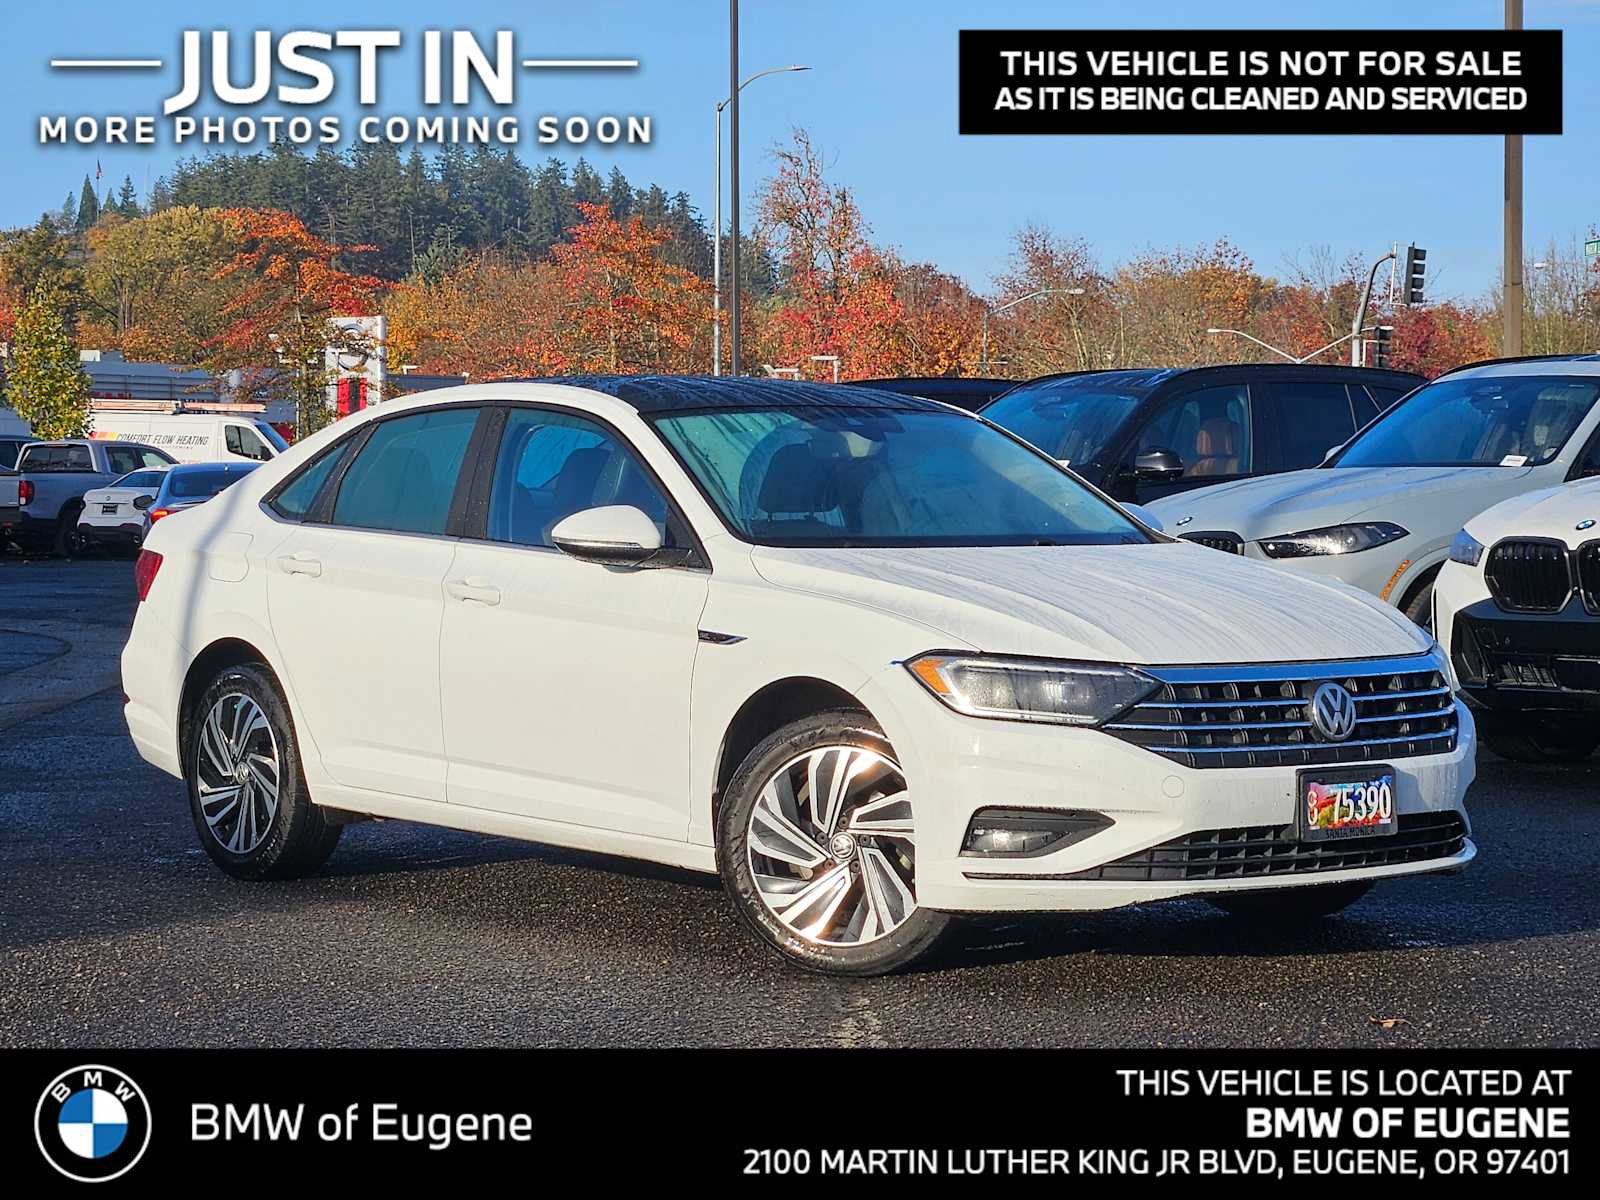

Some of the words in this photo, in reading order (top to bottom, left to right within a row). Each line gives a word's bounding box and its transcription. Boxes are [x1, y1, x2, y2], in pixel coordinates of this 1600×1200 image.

[153, 434, 176, 444] FLOW
[176, 435, 210, 446] HEATING
[1332, 782, 1392, 824] 75390
[1326, 829, 1348, 839] SANTA
[1349, 827, 1376, 837] MONICA
